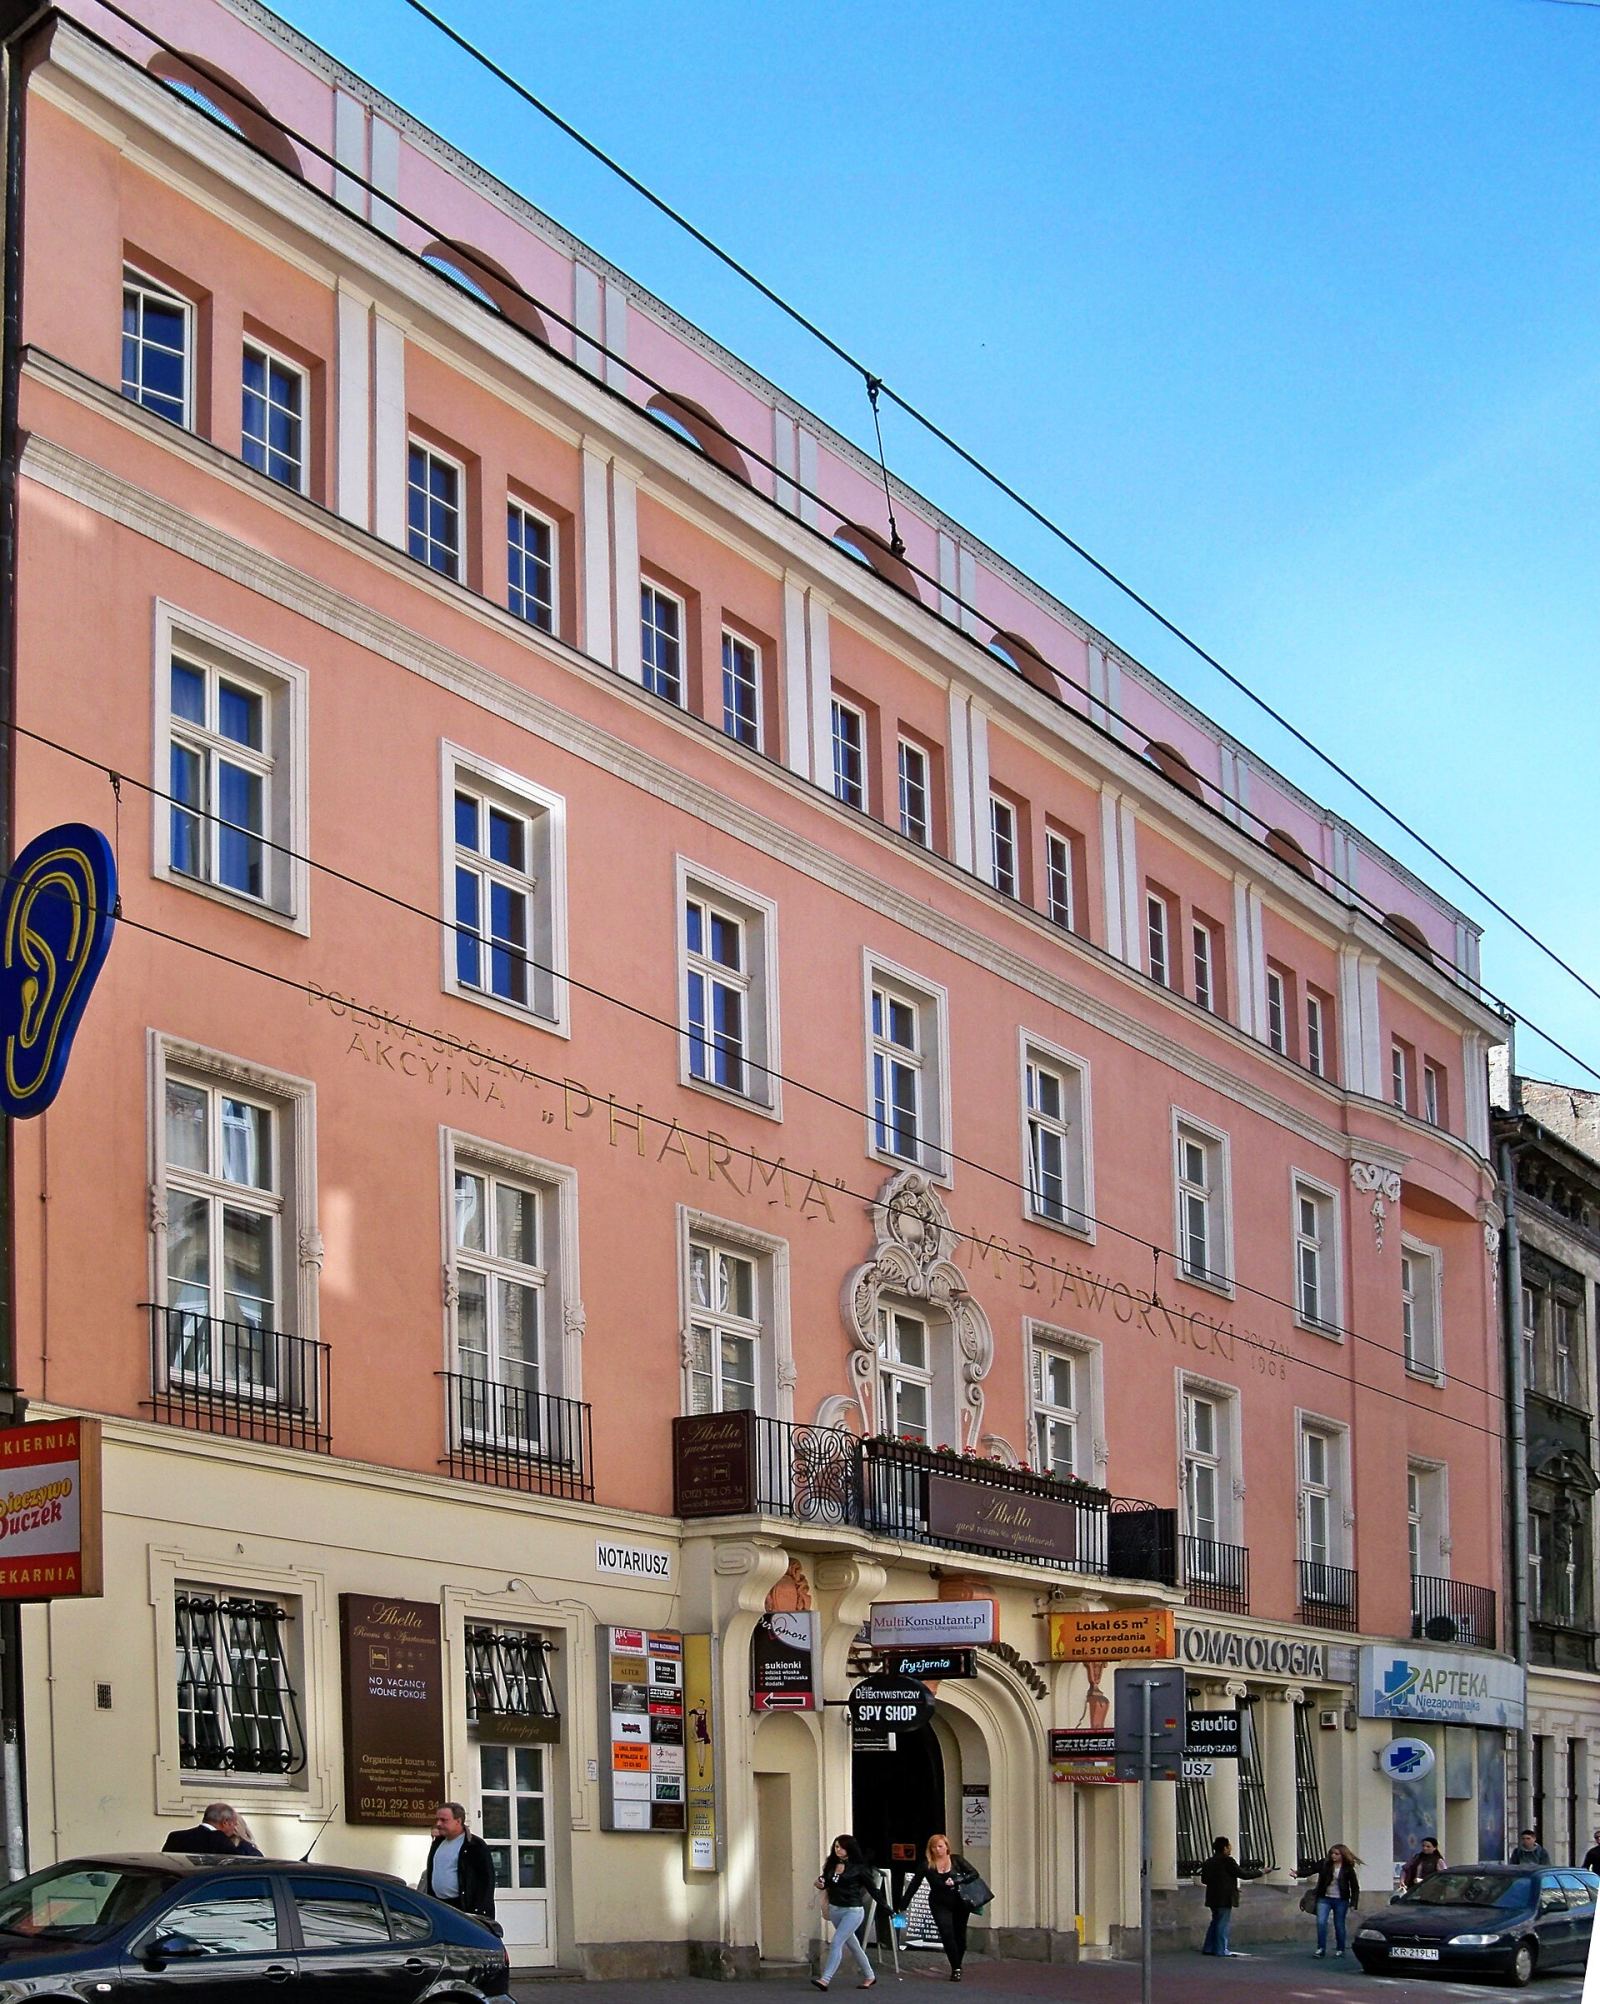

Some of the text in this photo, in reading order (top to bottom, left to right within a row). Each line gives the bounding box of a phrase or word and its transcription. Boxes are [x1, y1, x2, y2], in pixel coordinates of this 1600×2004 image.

[308, 981, 423, 1047] POLSKA
[347, 1033, 506, 1109] AKCYJNA
[1049, 1256, 1235, 1362] JAWORNICKI
[1251, 1356, 1286, 1381] 1908
[682, 1422, 740, 1442] Abella
[3, 1431, 77, 1455] KIERNIA
[977, 1496, 1032, 1528] Abella
[598, 1546, 669, 1575] NOTARIUSZ
[0, 1566, 76, 1584] EKARNIA
[367, 1601, 423, 1628] Abella
[873, 1613, 985, 1630] MultiKonsultant.pl
[1076, 1620, 1110, 1631] Lokal
[1113, 1620, 1128, 1630] 65
[1074, 1632, 1146, 1643] do sprzedania
[1071, 1647, 1088, 1656] tel.
[1090, 1646, 1110, 1655] 510
[1110, 1646, 1130, 1655] 080
[1132, 1645, 1151, 1654] 044
[1175, 1626, 1325, 1680] TOMATOLOGIA
[764, 1661, 802, 1670] sukienki
[899, 1659, 950, 1673] fryzjernia
[368, 1676, 426, 1689] NO VACANCY
[1419, 1667, 1488, 1699] APTEKA
[369, 1687, 427, 1700] WOLNE POKOJE
[855, 1687, 921, 1700] DETEKTYWISTYCZNY
[1415, 1694, 1480, 1713] Niezapominajka
[859, 1705, 917, 1721] SPY SHOP
[1190, 1715, 1238, 1732] studio
[362, 1754, 402, 1766] Organised
[360, 1797, 440, 1810] (012) 292 05 34
[1392, 1947, 1407, 1956] KR
